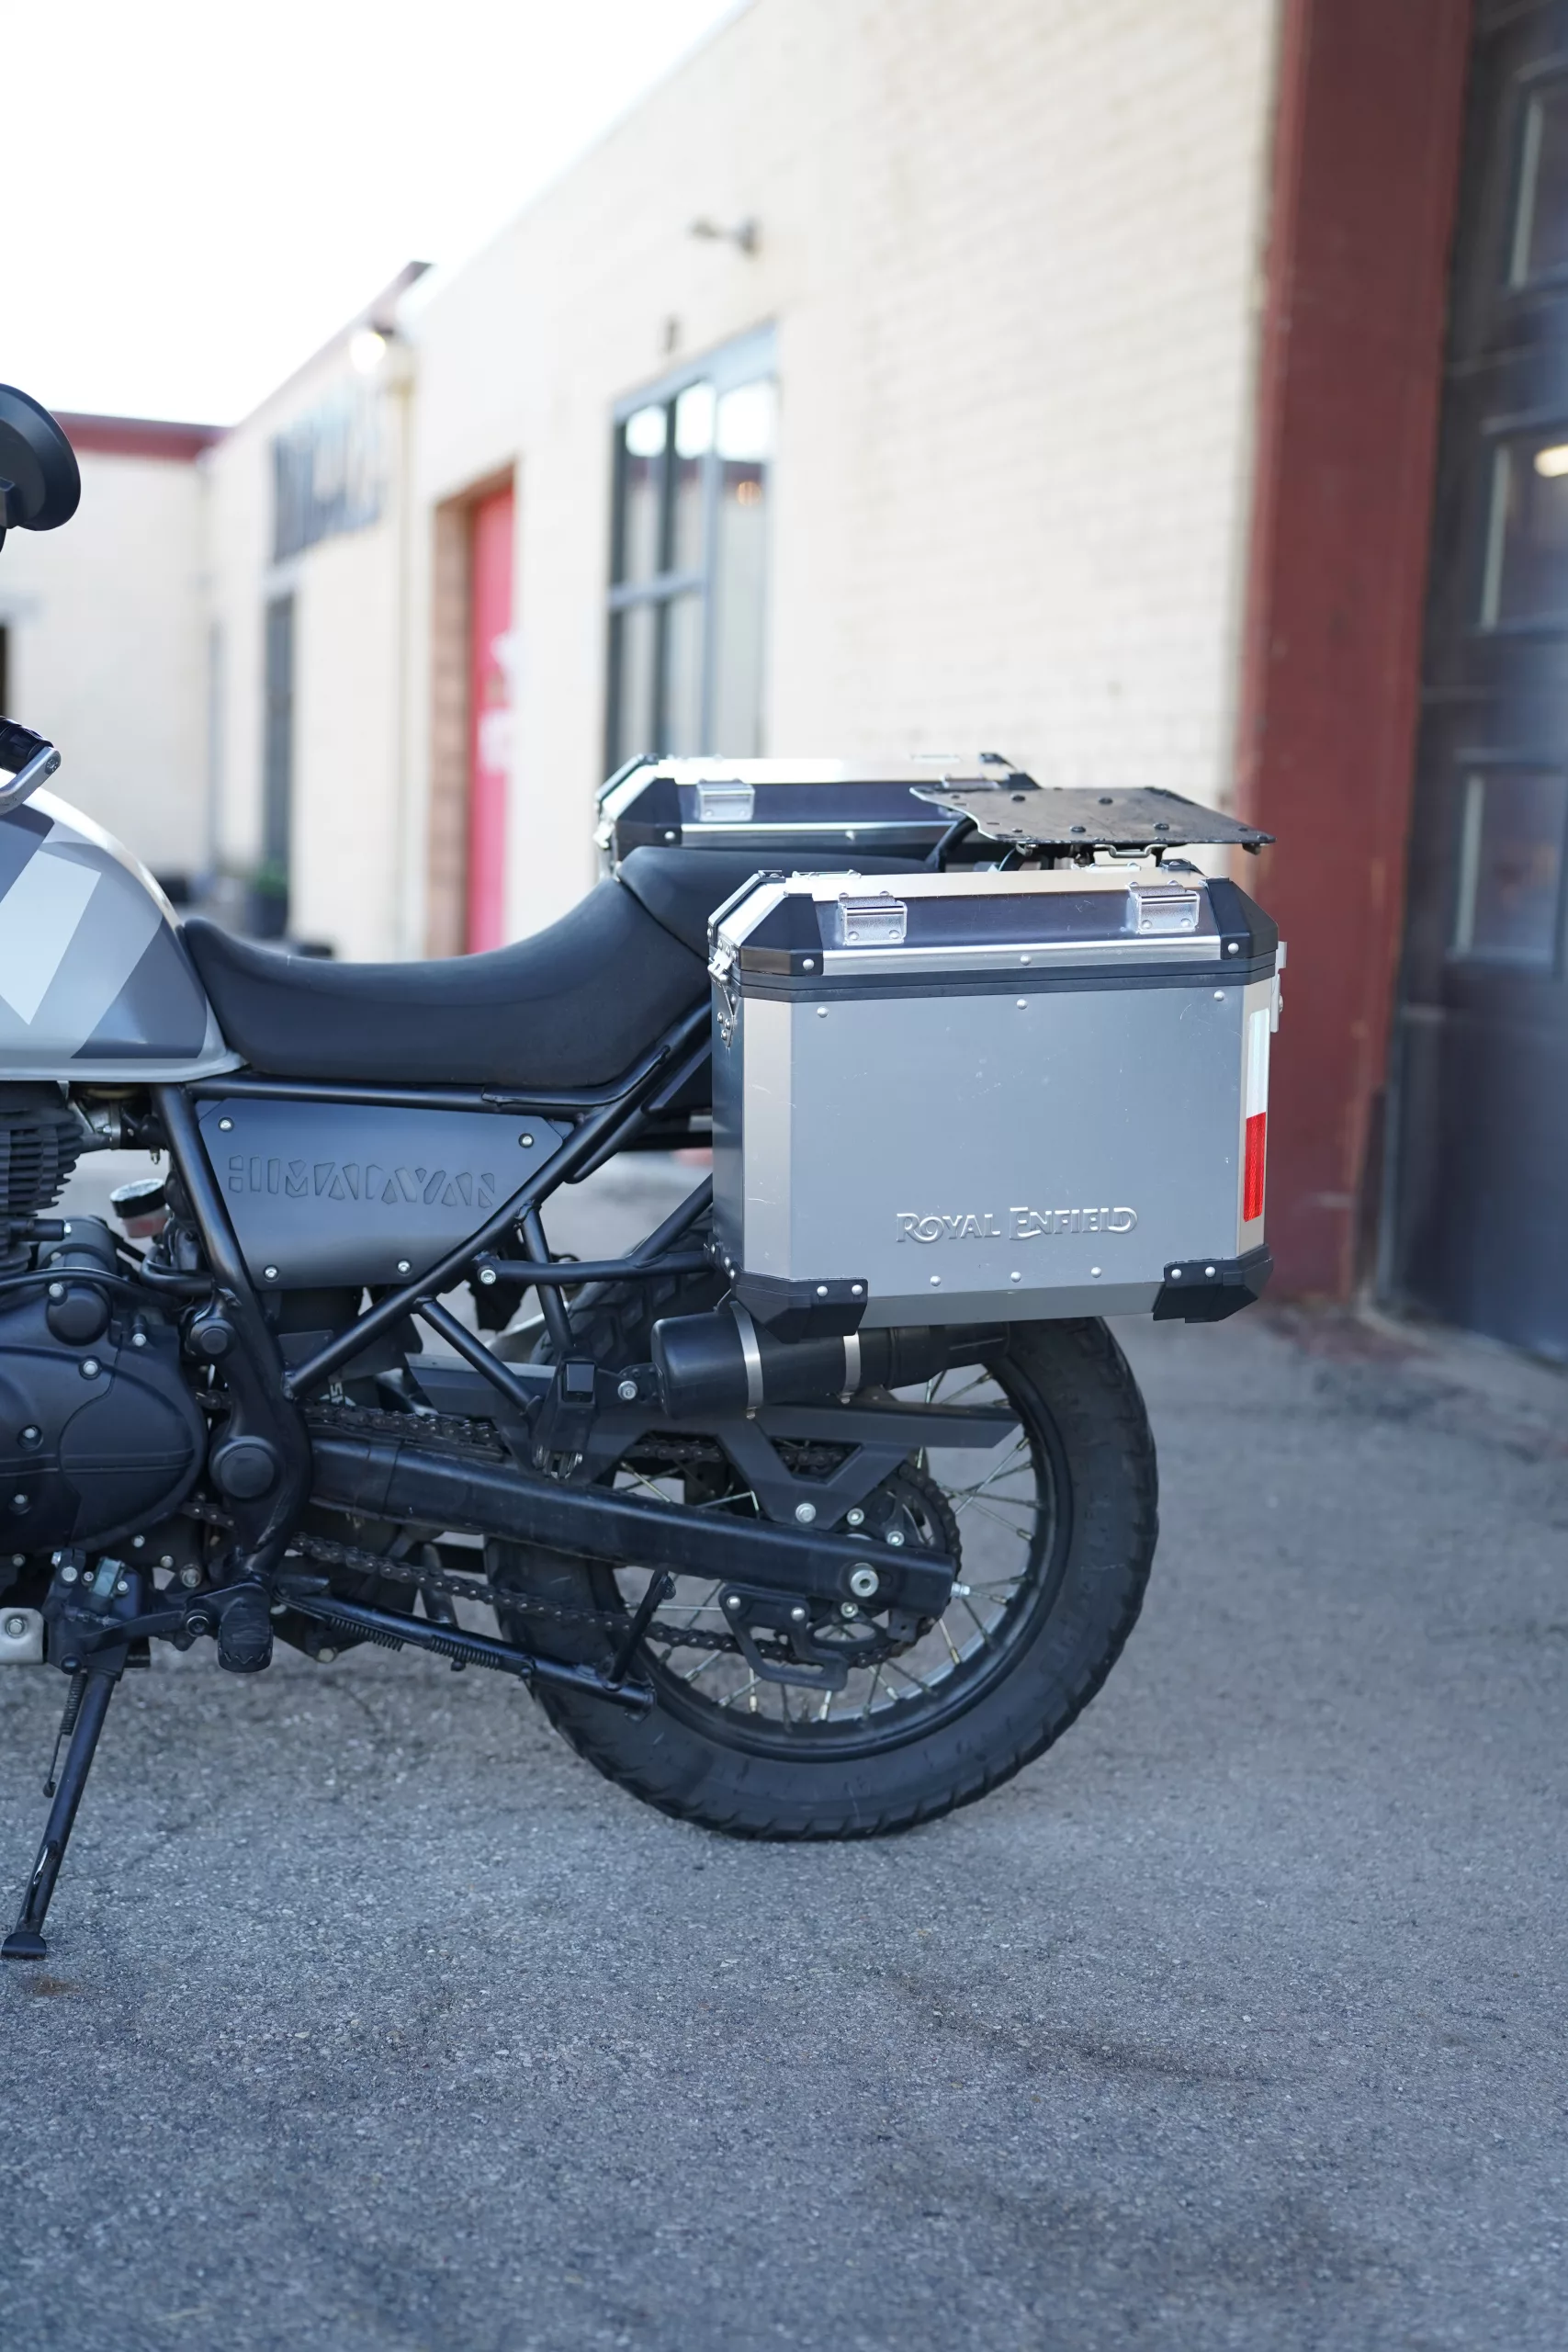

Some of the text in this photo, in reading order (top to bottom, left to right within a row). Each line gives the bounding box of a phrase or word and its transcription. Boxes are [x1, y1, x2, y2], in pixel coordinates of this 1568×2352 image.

[224, 1154, 500, 1209] HIMALAYAN
[896, 1206, 1139, 1244] ROYAL ENFIELD
